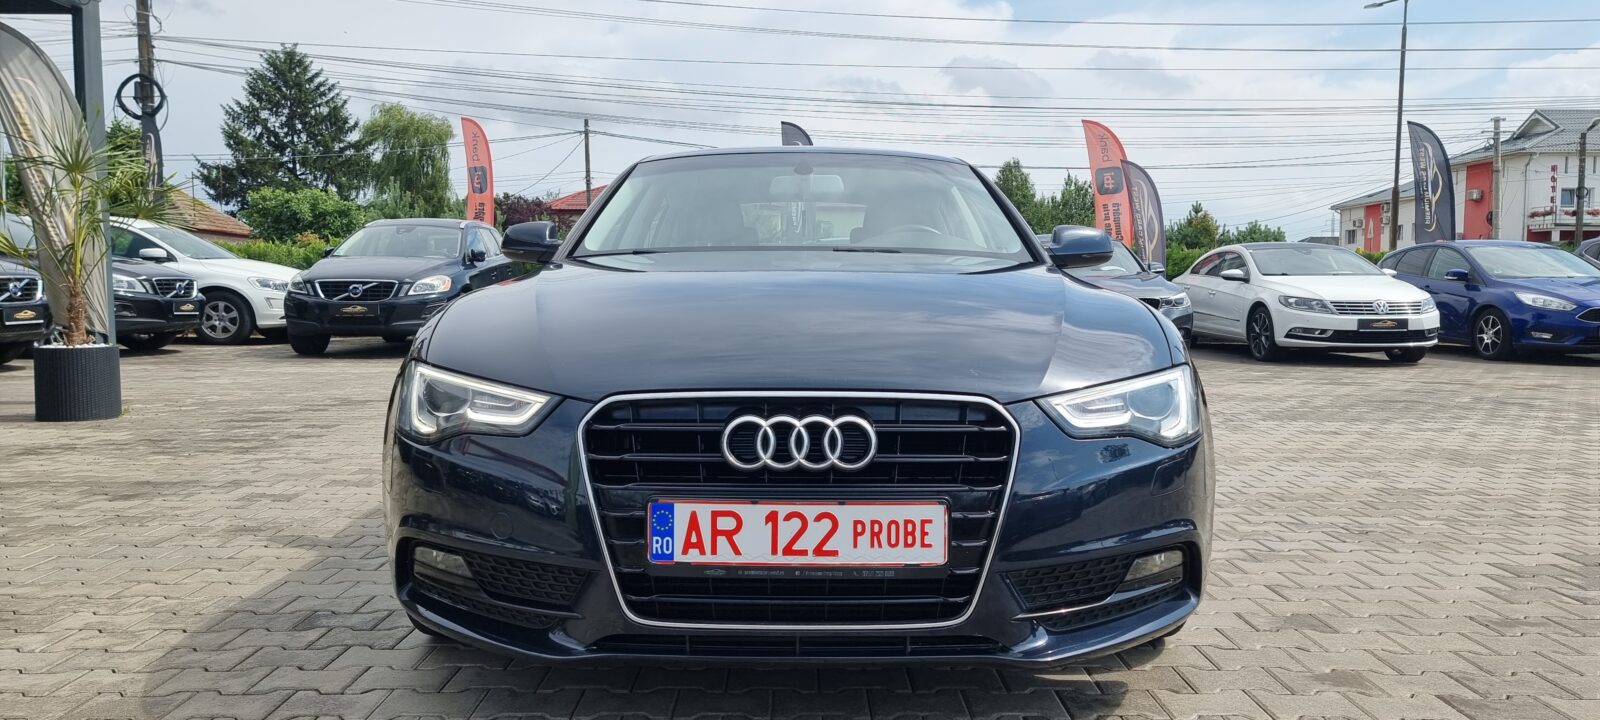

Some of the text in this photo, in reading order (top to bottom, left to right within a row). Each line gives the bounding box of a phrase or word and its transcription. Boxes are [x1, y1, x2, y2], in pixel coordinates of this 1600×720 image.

[652, 536, 672, 554] RO
[681, 510, 933, 557] AR 122 PROBE
